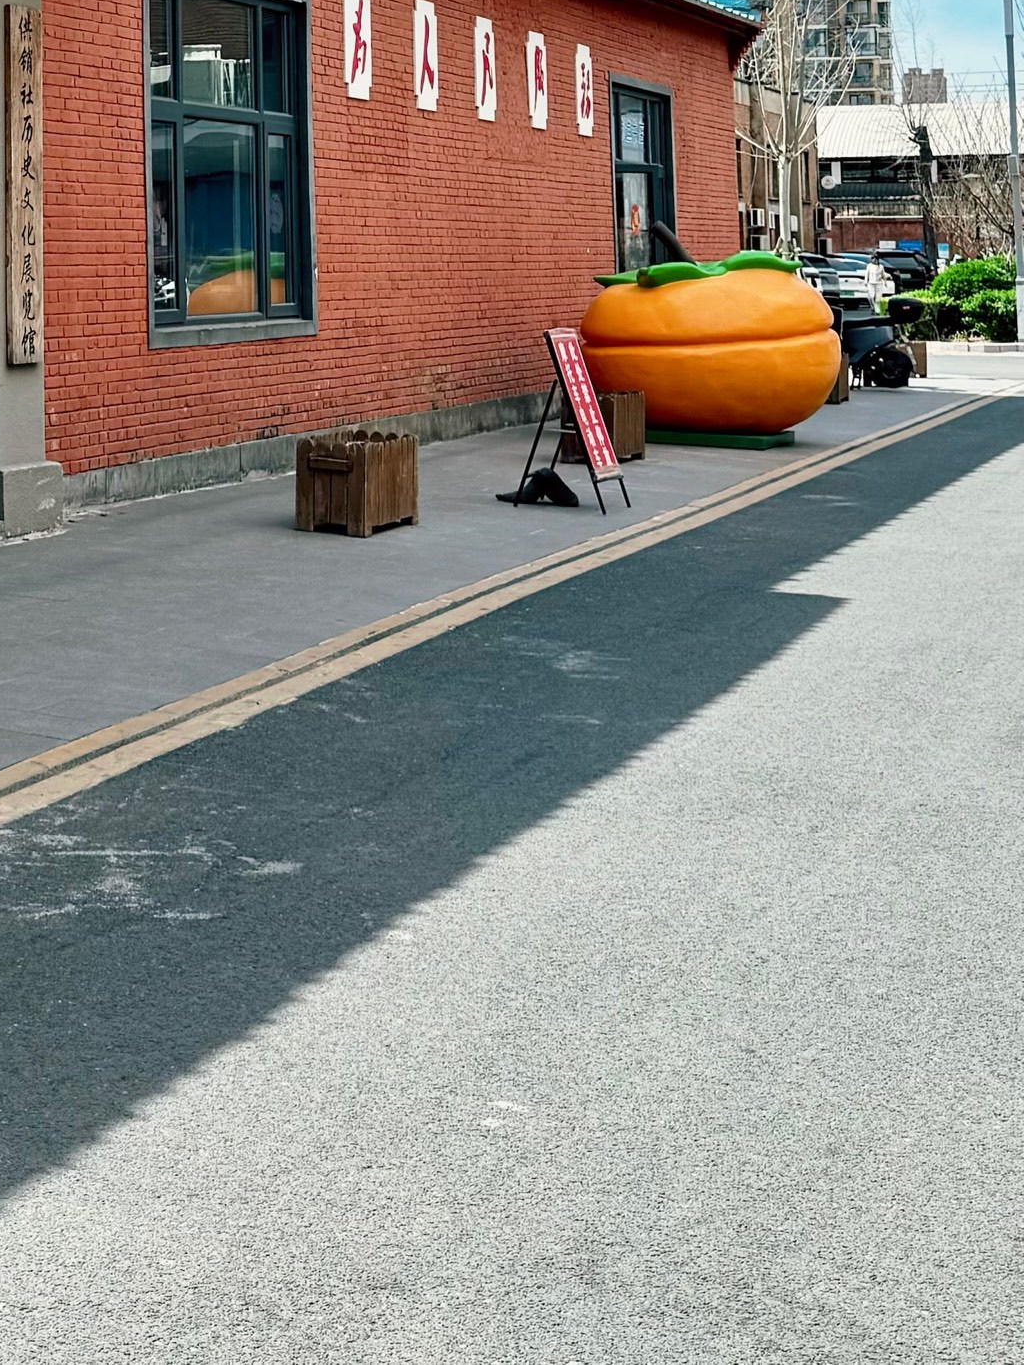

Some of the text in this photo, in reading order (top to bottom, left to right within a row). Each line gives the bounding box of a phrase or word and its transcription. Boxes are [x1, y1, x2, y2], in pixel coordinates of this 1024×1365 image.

[18, 14, 37, 358] 供销社历史文化展览馆
